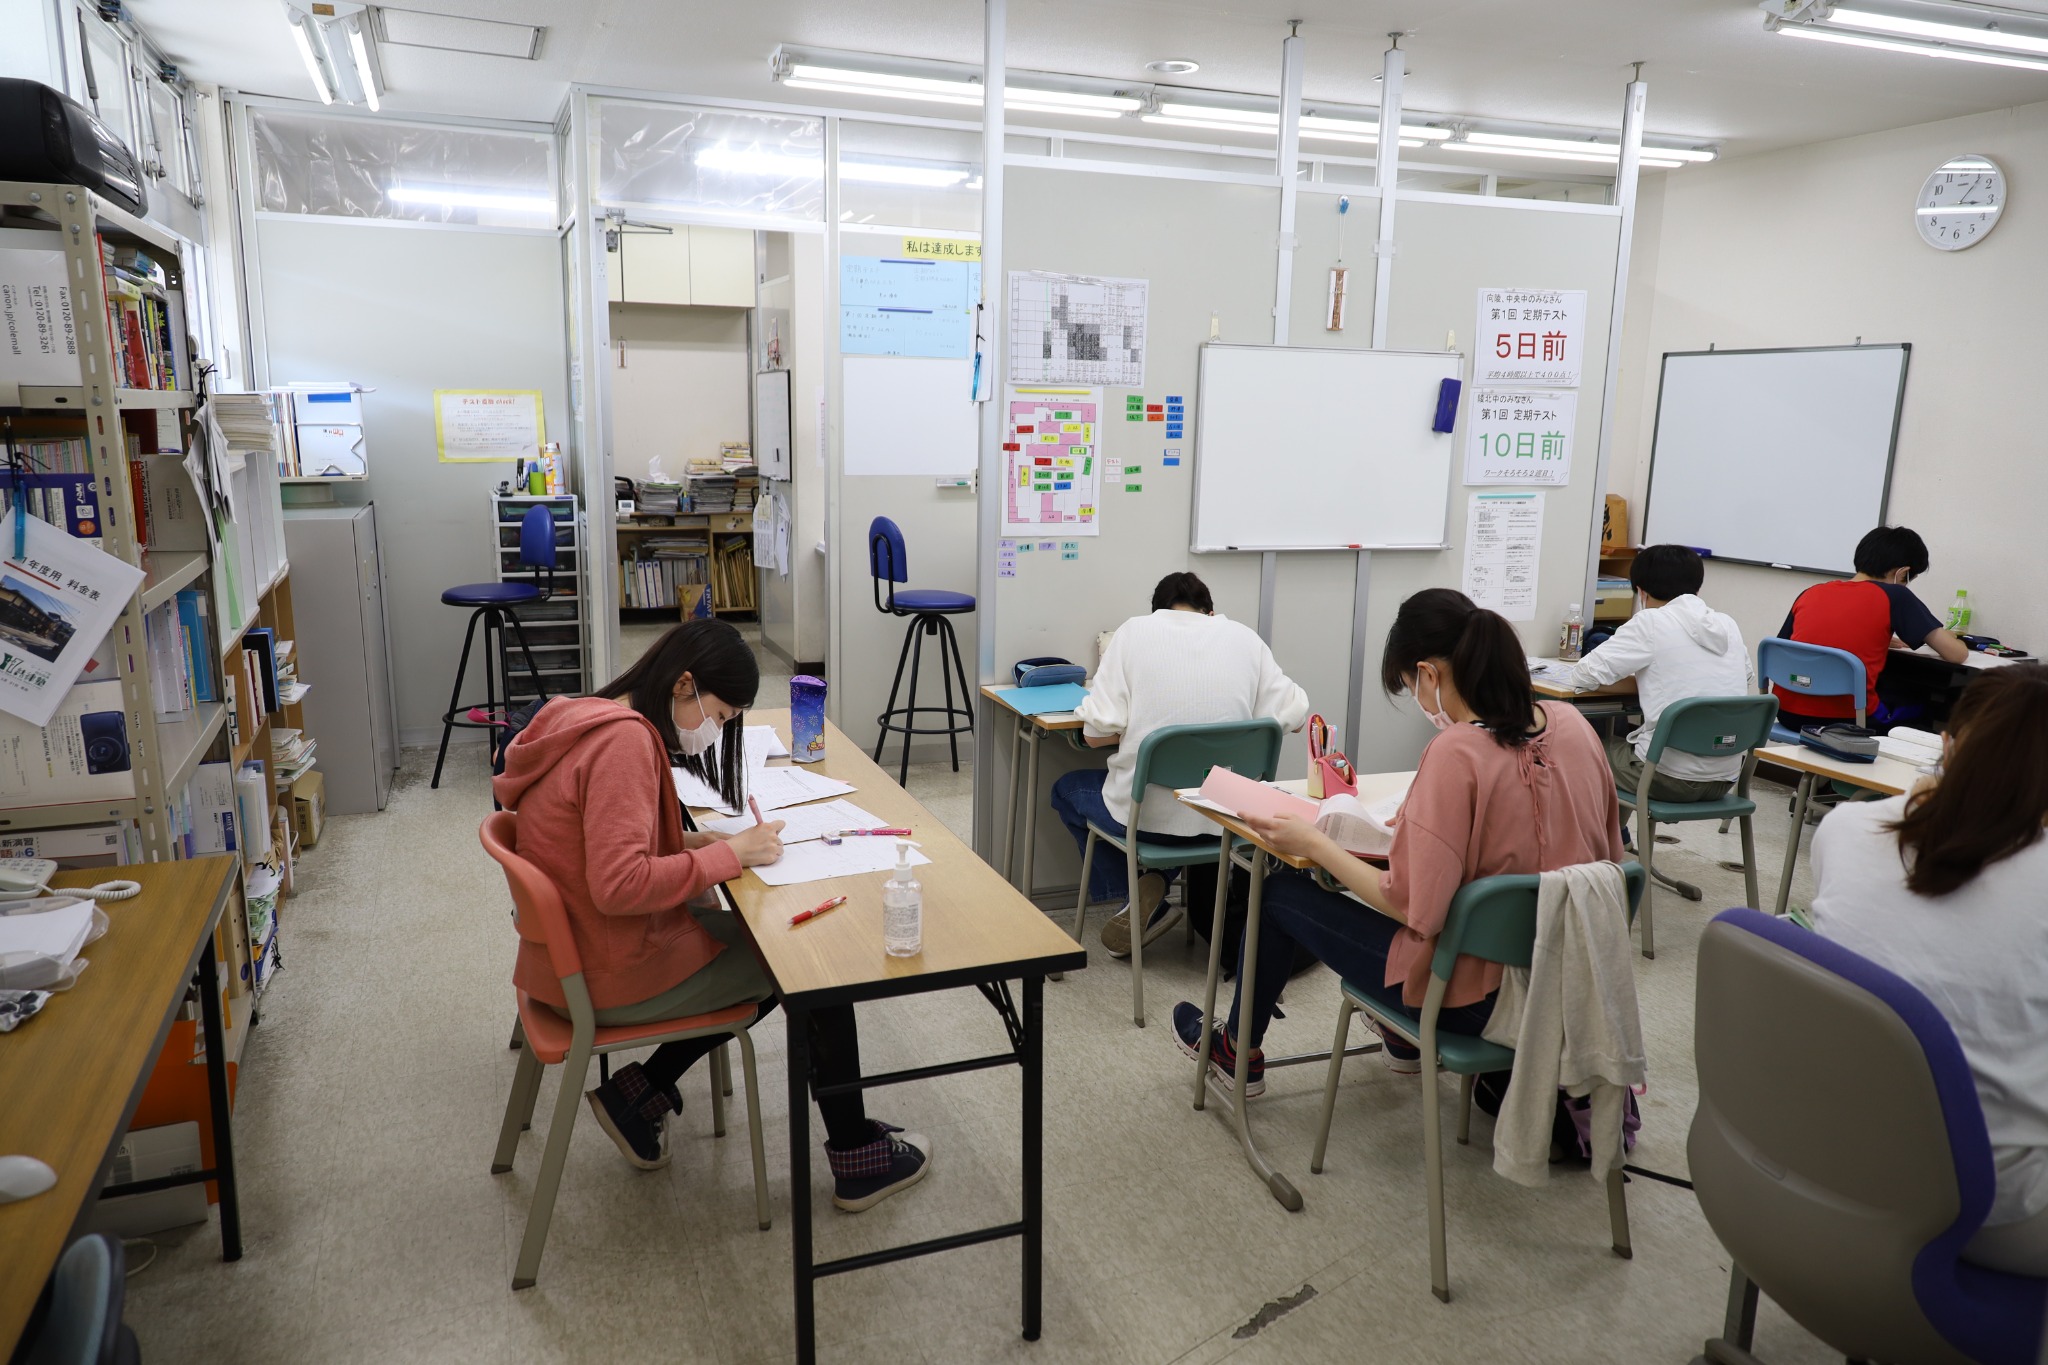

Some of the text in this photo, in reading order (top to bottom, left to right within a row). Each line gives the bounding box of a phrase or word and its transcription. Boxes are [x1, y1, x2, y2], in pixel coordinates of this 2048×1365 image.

[1985, 178, 1992, 189] 2
[1934, 185, 1943, 196] 10
[1987, 194, 1994, 204] 3
[1931, 216, 1937, 226] 8
[1940, 227, 1946, 236] 7
[1953, 229, 1960, 239] 6
[1968, 224, 1975, 234] 5
[2, 284, 22, 355] canon.jp/colemall
[1491, 308, 1568, 321] 第1回 定期テスト
[59, 286, 76, 355] Fax:0120-89-2888
[1495, 329, 1568, 362] 5日前
[1481, 408, 1557, 421] 第1回 定期テスト
[1479, 430, 1566, 461] 10日前
[12, 555, 102, 602] 1年度用 料金表
[1, 837, 34, 848] 新演習
[15, 847, 35, 858] 小6
